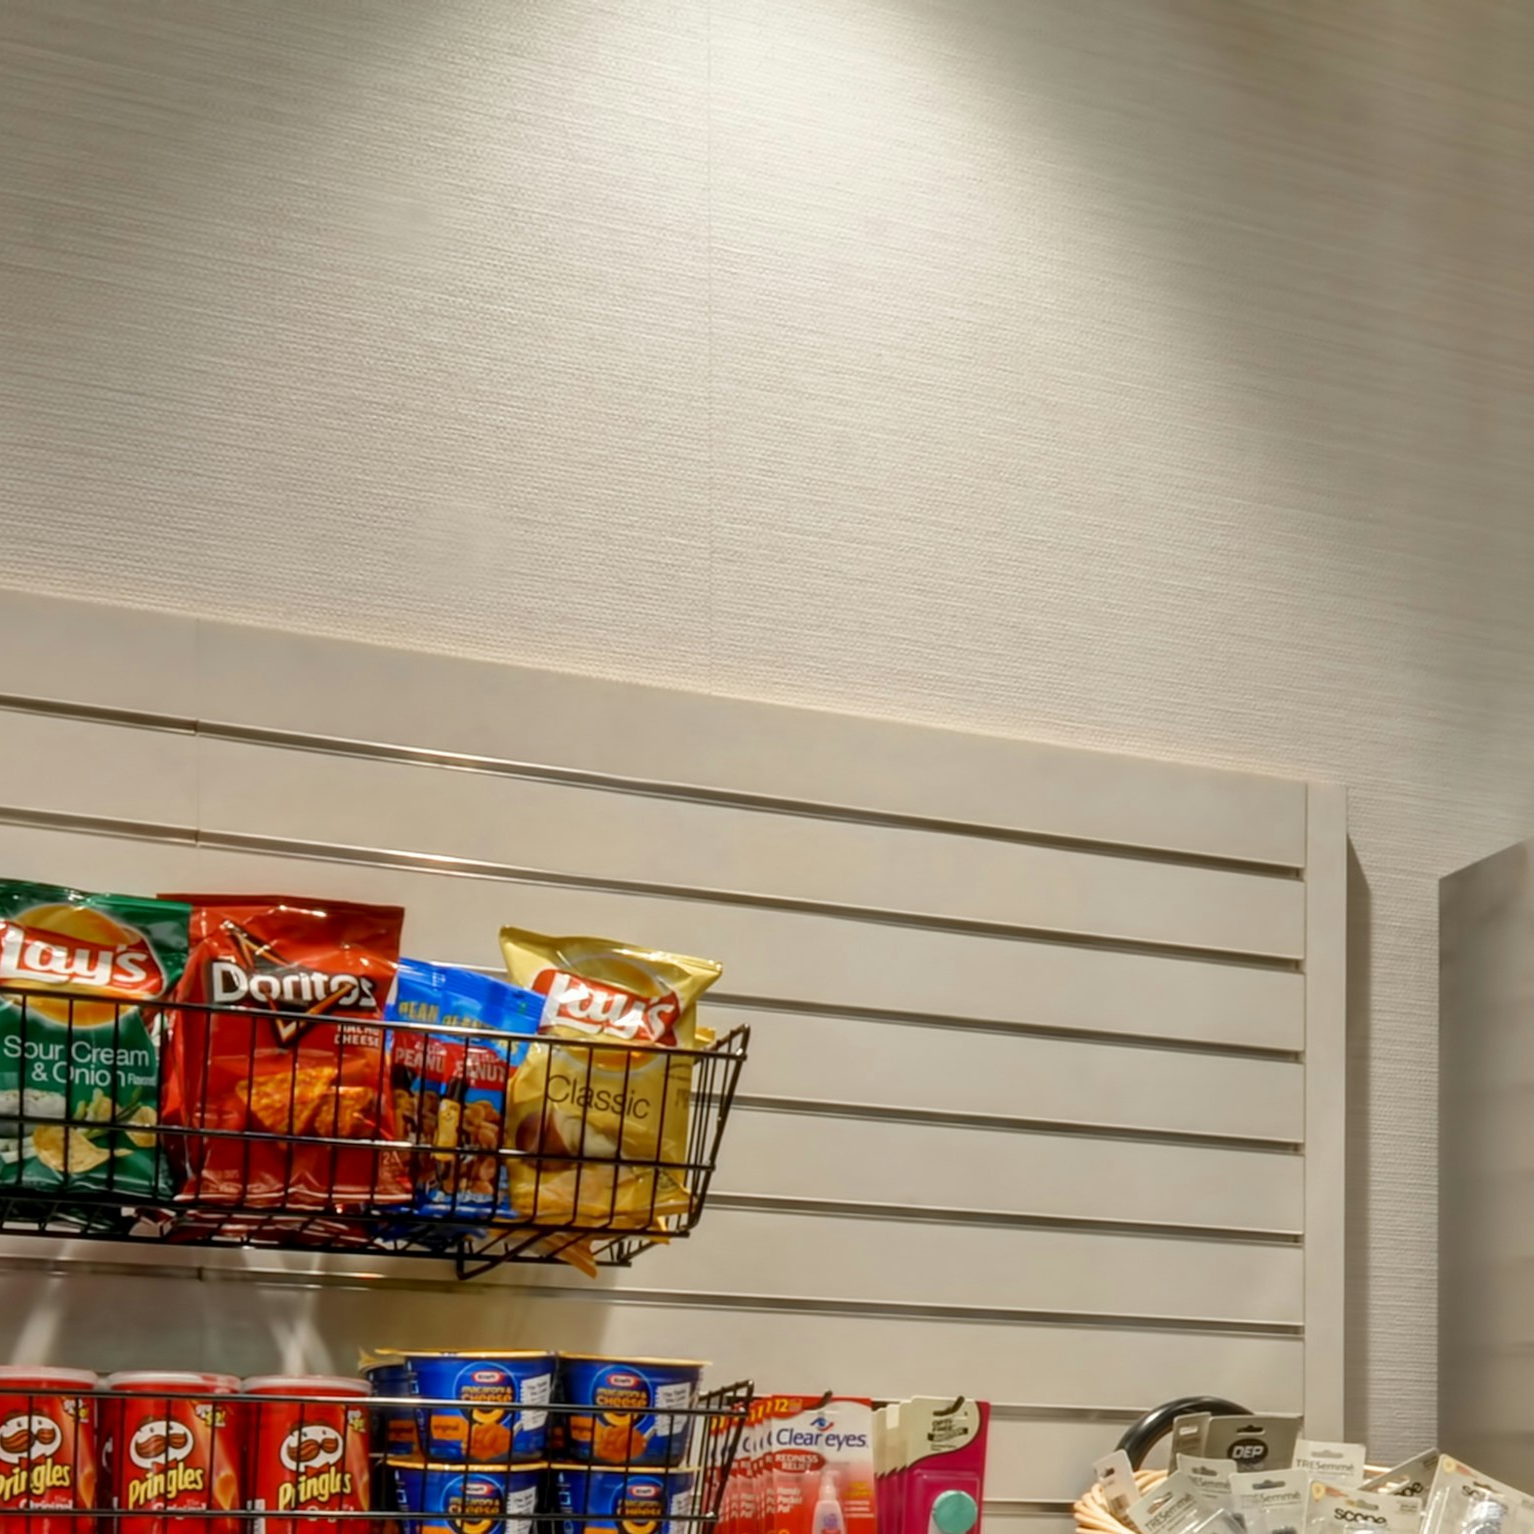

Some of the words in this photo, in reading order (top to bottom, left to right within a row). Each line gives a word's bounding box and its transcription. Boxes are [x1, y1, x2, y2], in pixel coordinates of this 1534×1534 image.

[211, 961, 378, 1008] Doritos
[547, 972, 678, 1043] Lay's
[3, 1034, 65, 1065] Sour
[70, 1038, 149, 1068] Cream
[32, 1061, 50, 1083] &
[54, 1060, 127, 1088] Onion
[545, 1073, 652, 1122] Classic
[776, 1428, 825, 1446] Clear
[826, 1432, 867, 1452] eyes
[1231, 1444, 1265, 1460] DEP
[126, 1462, 205, 1511] Pringles
